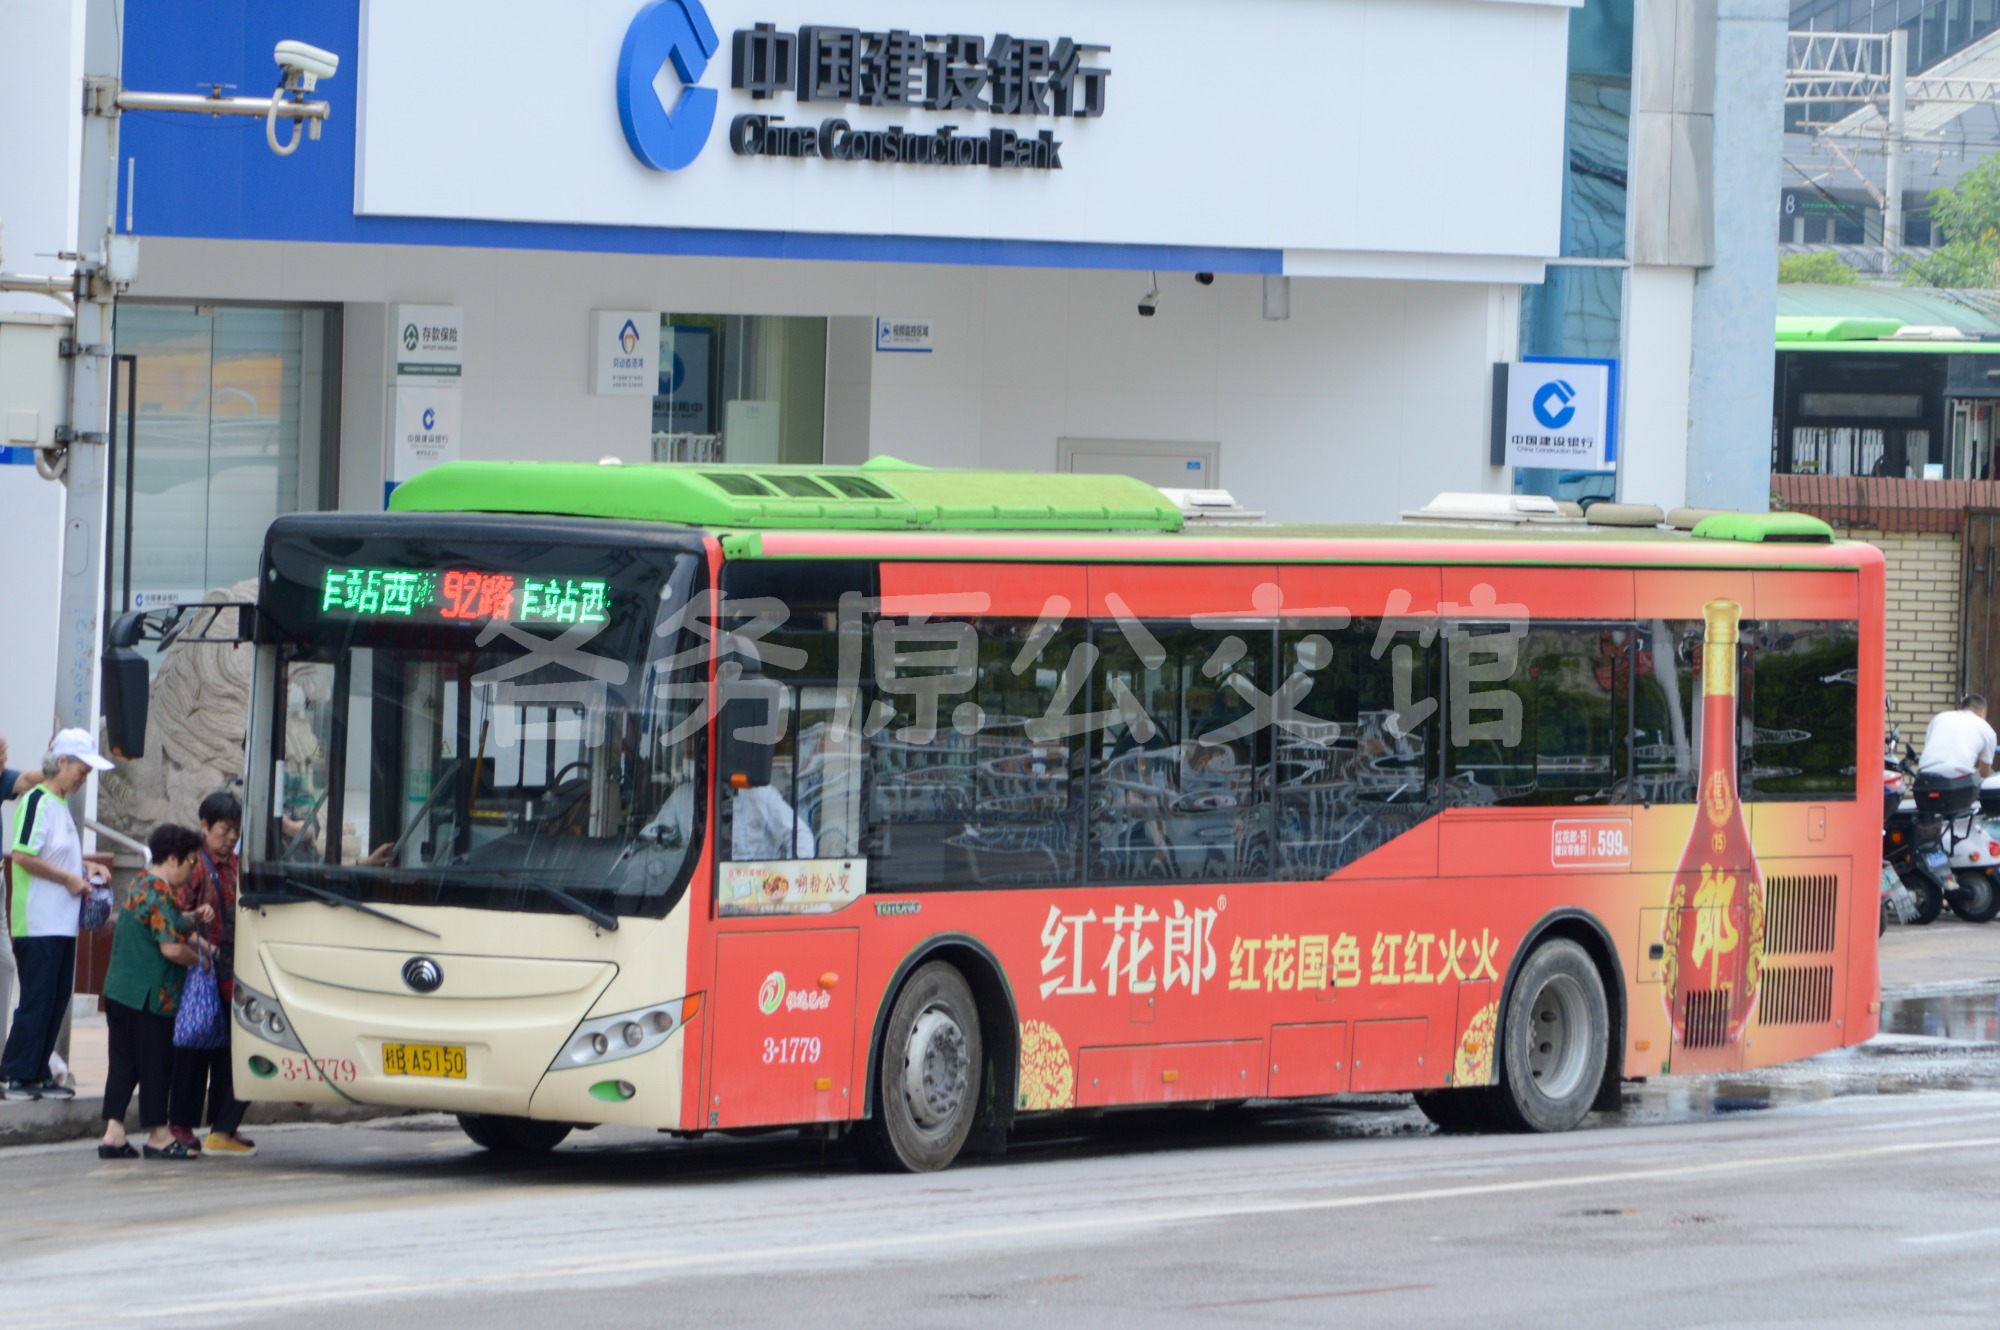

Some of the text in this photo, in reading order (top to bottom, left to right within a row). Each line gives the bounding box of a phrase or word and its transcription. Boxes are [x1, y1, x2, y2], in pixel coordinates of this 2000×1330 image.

[731, 22, 1111, 118] 中国建设银行
[729, 113, 1063, 169] China Construction Bank
[1785, 194, 1795, 214] 8
[422, 326, 458, 343] 存款保险
[1511, 435, 1594, 448] 中国建设银行
[323, 569, 437, 616] 站西
[441, 570, 515, 620] 92路
[1713, 833, 1723, 850] 15
[1228, 927, 1500, 993] 红花国色 红红火火
[762, 1036, 821, 1064] 3-1779
[281, 1057, 357, 1083] 3-1779
